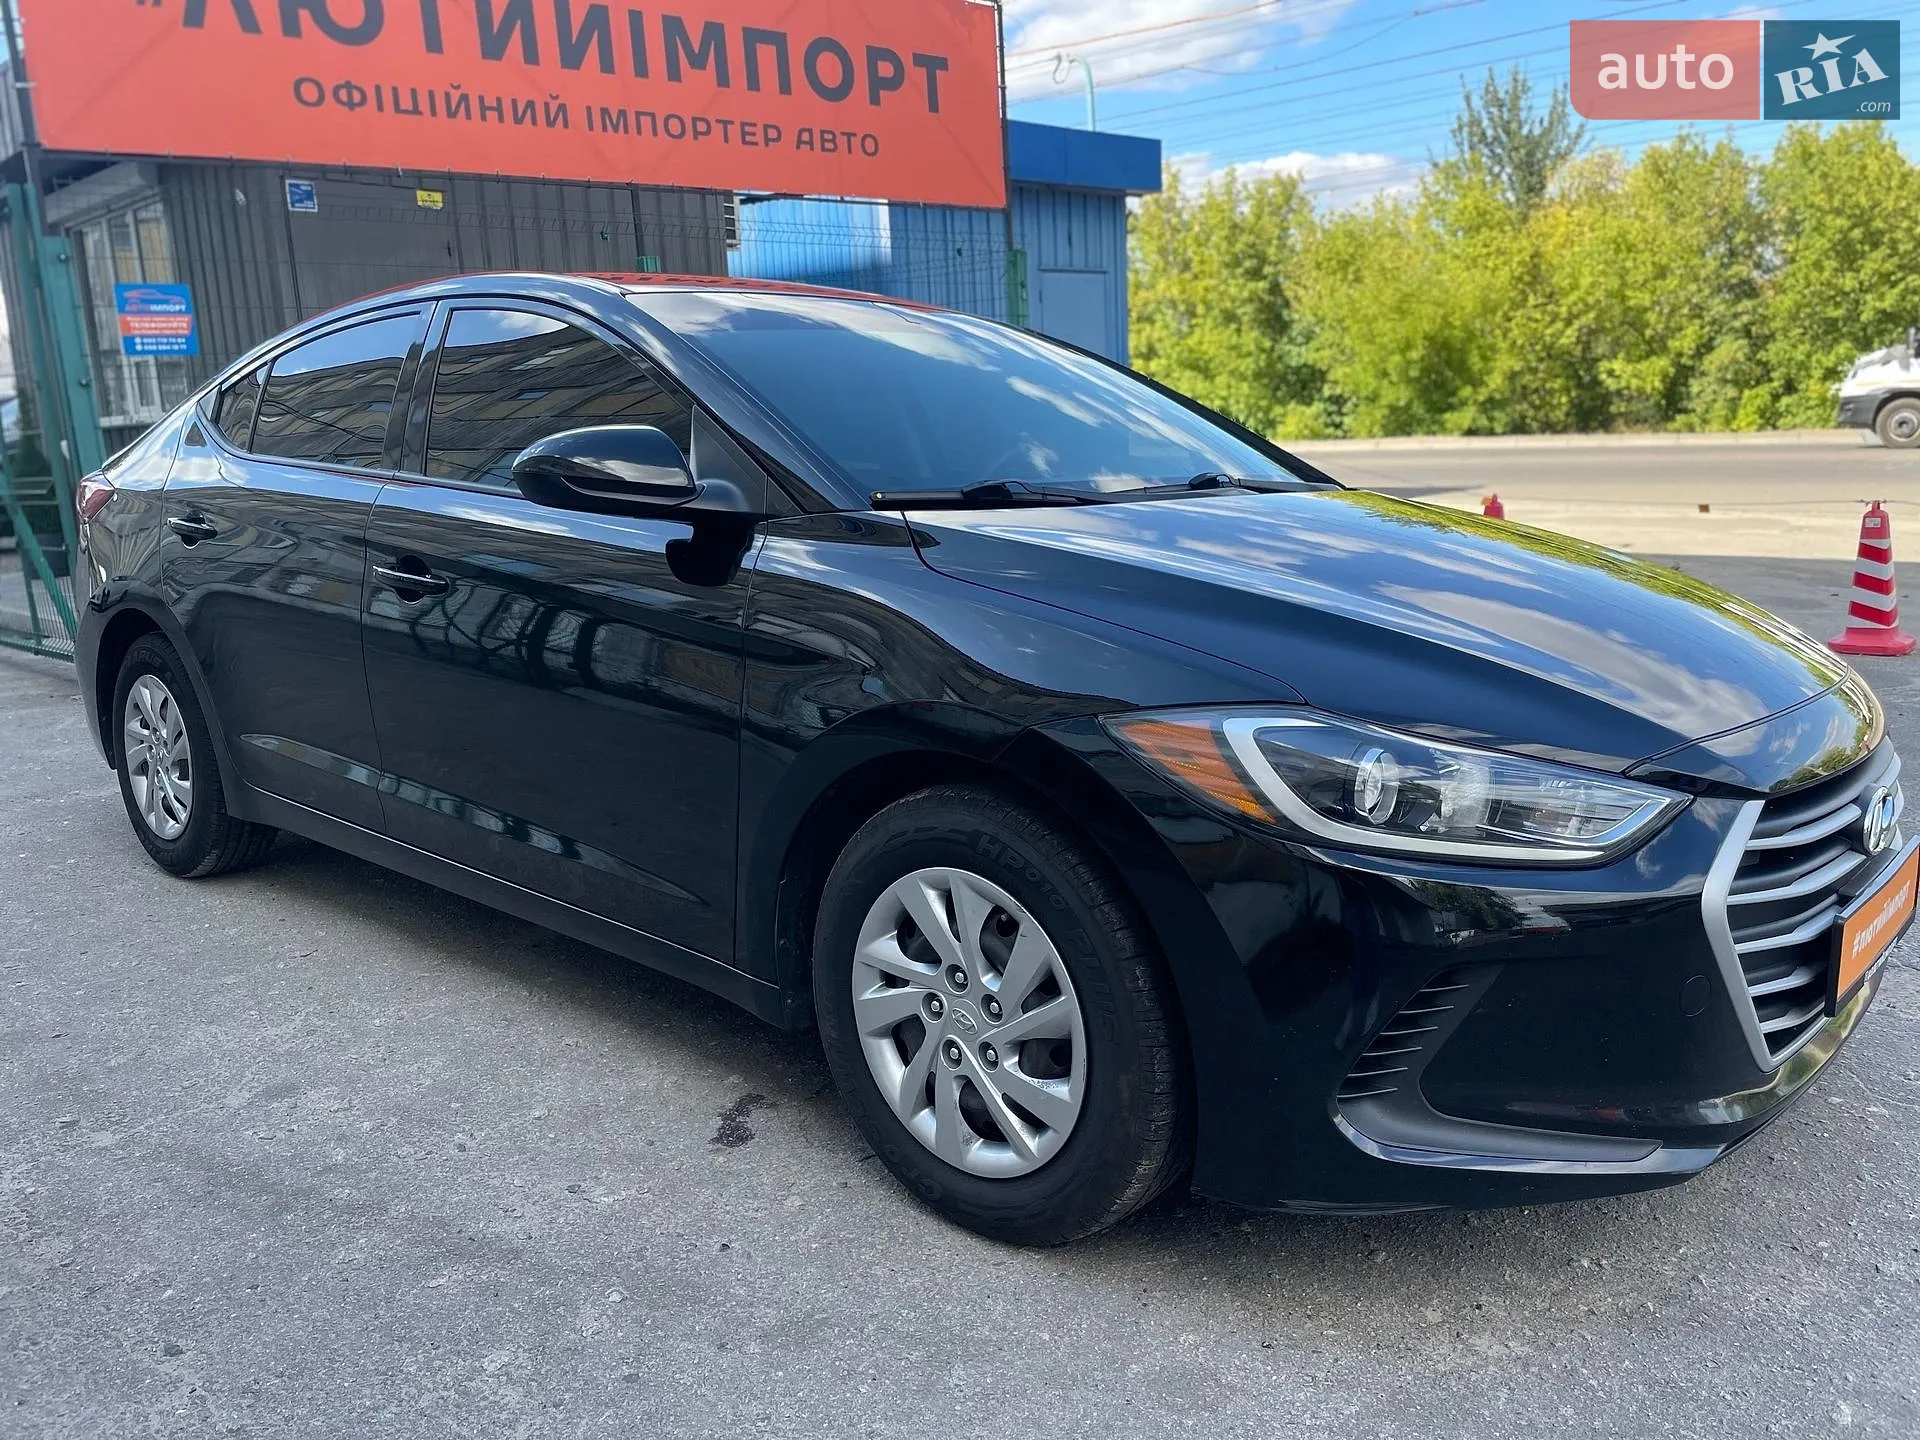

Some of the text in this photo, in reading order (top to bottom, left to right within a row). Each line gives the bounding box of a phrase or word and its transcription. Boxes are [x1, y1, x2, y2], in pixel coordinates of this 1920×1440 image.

[292, 76, 880, 158] ОФІЦІЙНИЙ ІМПОРТЕР АВТО
